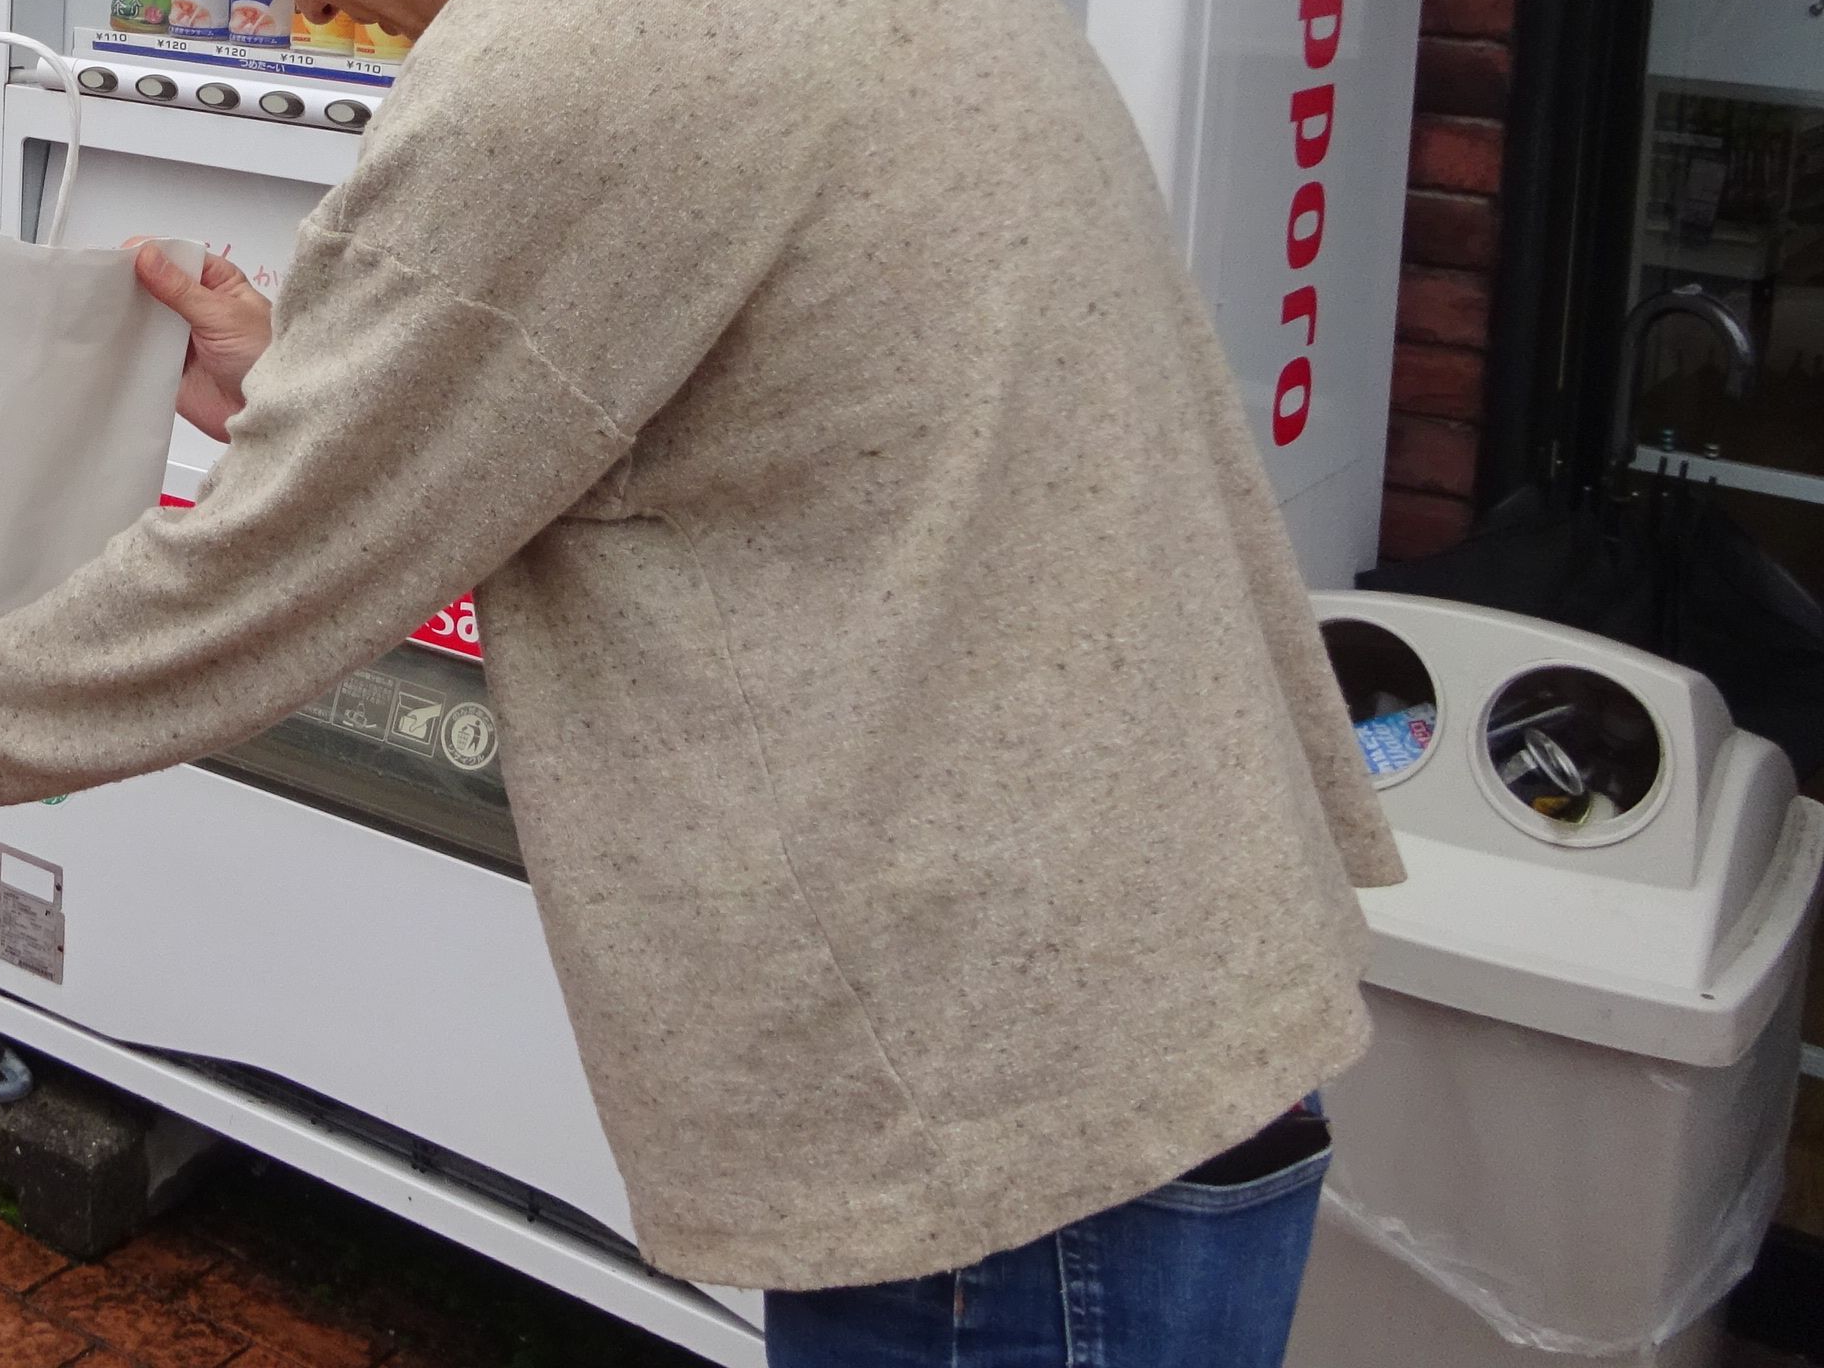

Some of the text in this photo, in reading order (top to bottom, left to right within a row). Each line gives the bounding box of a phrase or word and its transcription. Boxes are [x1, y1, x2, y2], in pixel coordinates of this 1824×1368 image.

[96, 33, 127, 42] ¥110
[157, 39, 187, 50] ¥120
[216, 46, 247, 57] ¥120
[280, 54, 314, 65] ¥110
[347, 61, 381, 74] ¥110
